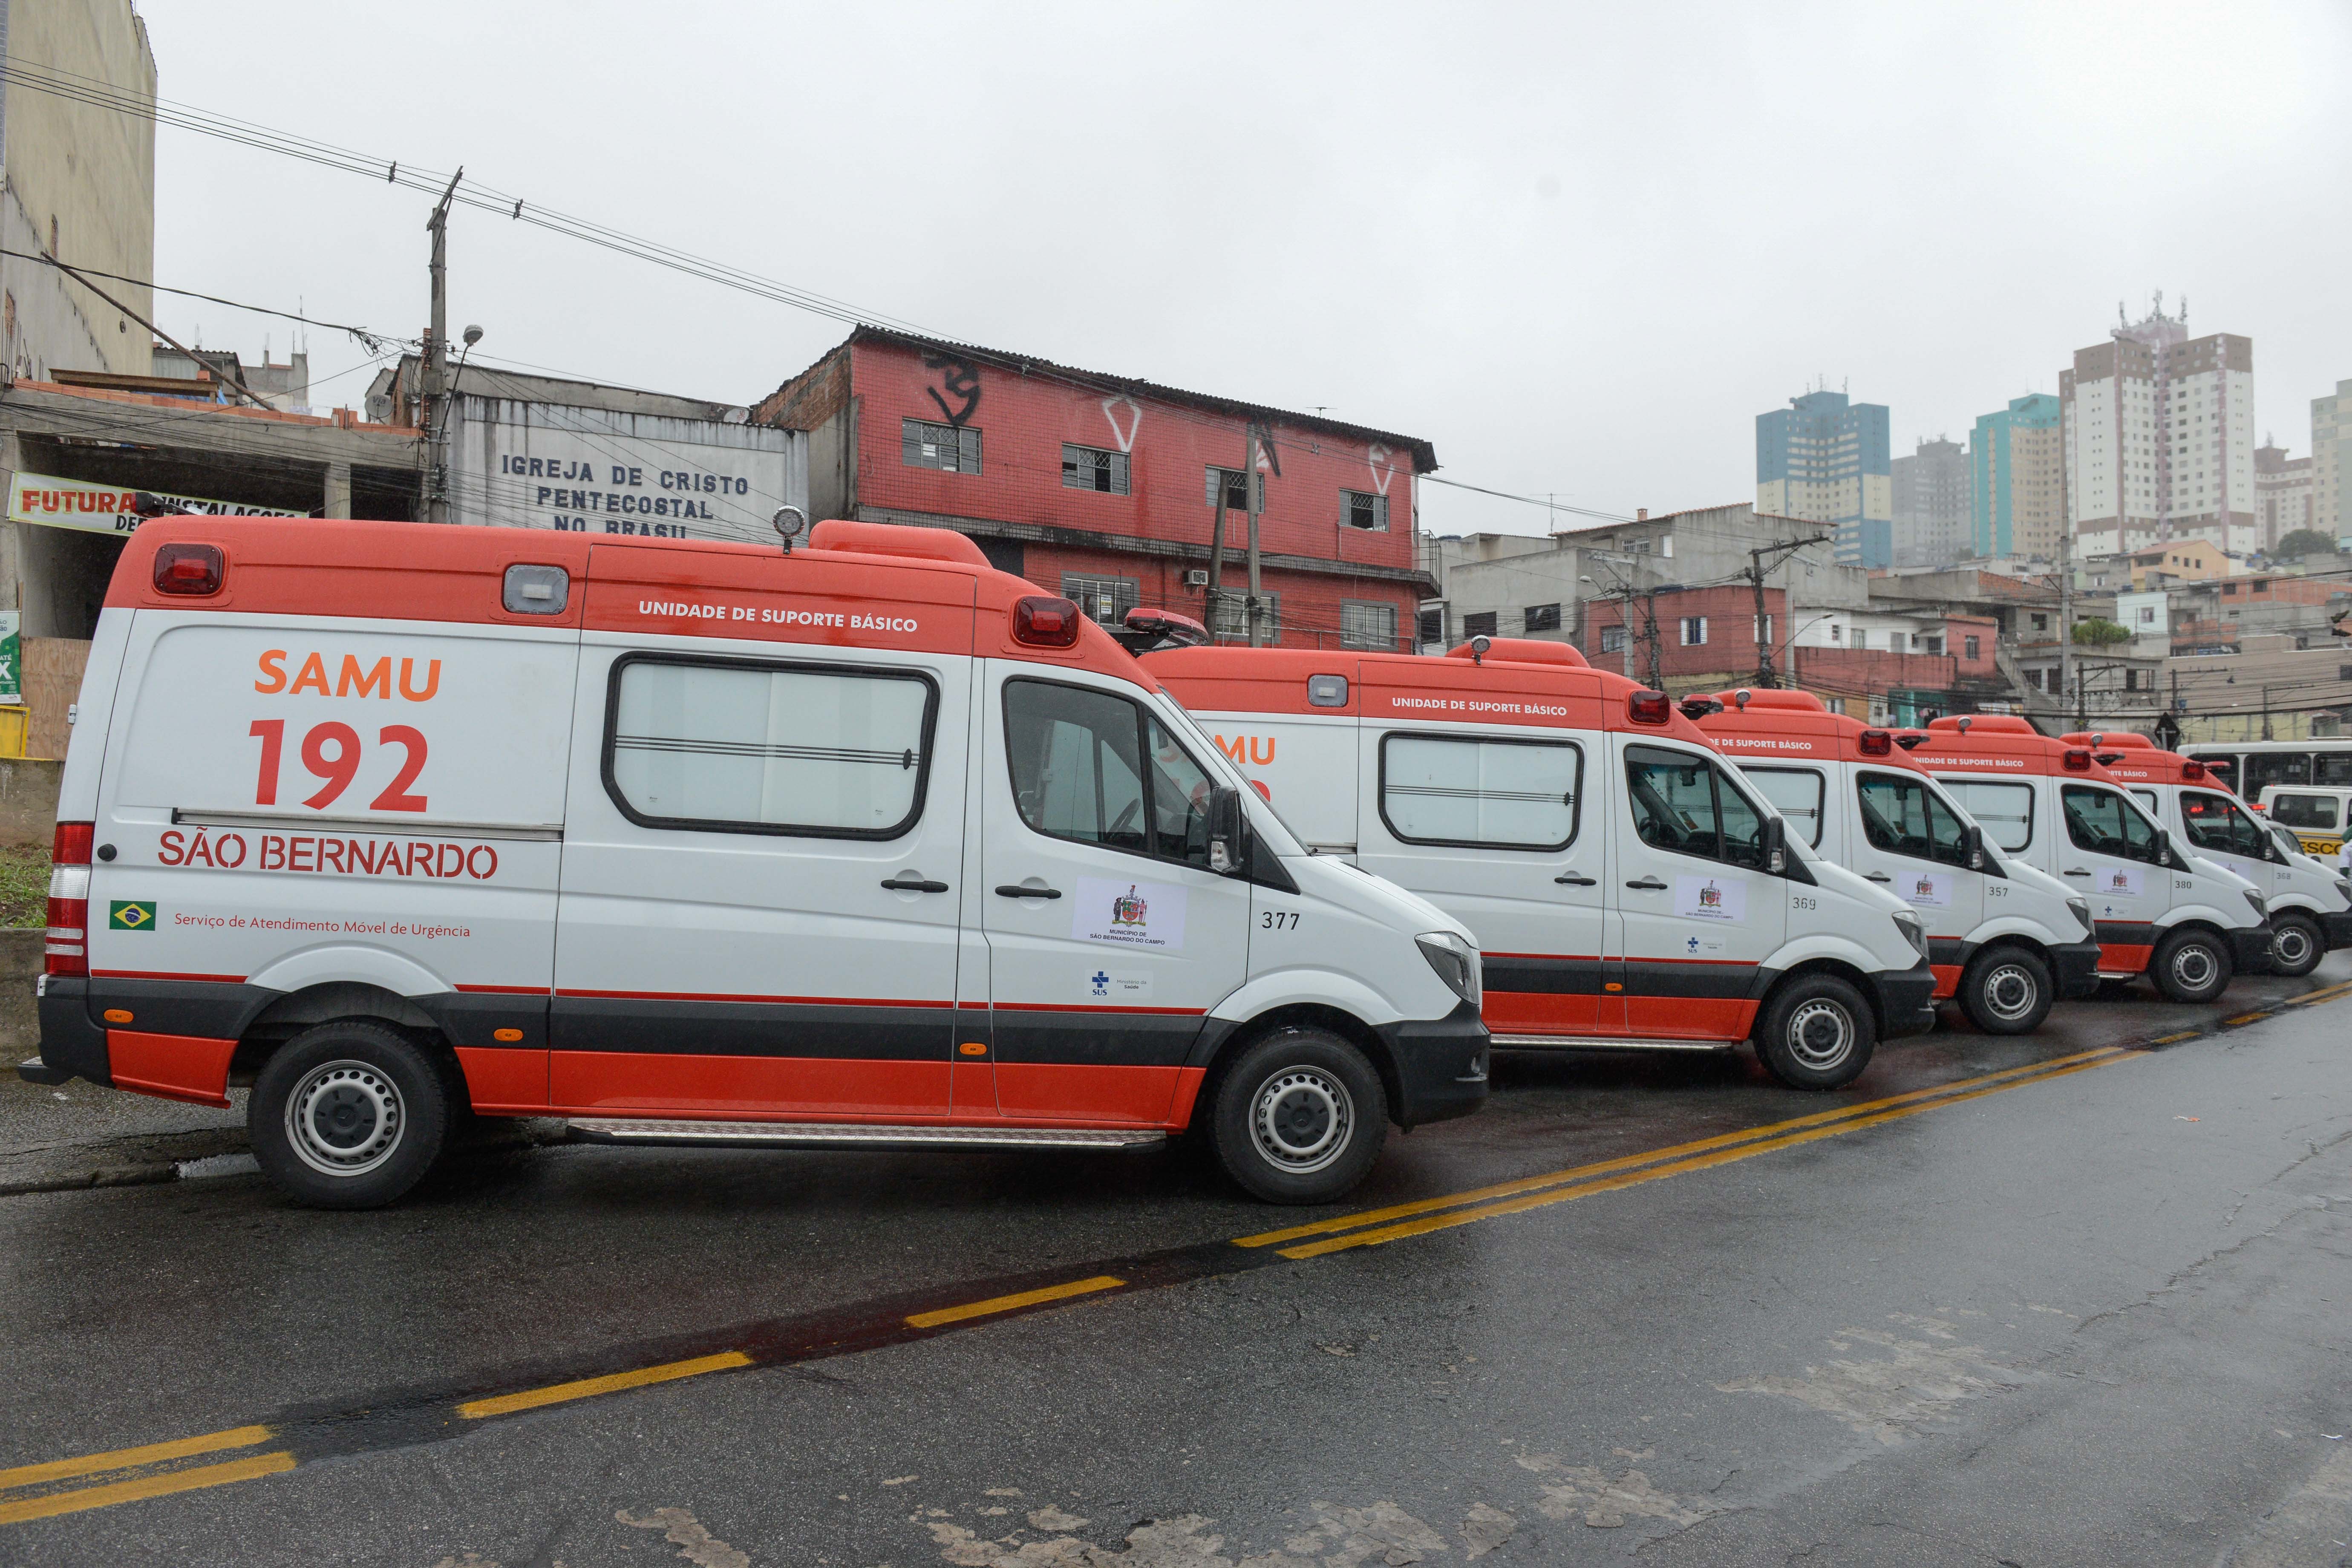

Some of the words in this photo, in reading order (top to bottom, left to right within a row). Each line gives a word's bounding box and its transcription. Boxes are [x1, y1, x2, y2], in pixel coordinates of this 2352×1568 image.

[503, 455, 593, 481] IGREJA
[612, 466, 642, 485] DE
[661, 470, 748, 495] CRISTO
[538, 486, 713, 519] PENTECOSTAL
[554, 516, 585, 531] NO
[639, 601, 726, 619] UNIDADE
[732, 607, 755, 621] DE
[762, 609, 844, 627] SUPORTE
[851, 613, 917, 632] BÁSICO
[255, 649, 441, 702] SAMU
[1392, 698, 1447, 709] UNIDADE
[1450, 700, 1465, 710] DE
[1469, 702, 1521, 713] SUPORTE
[1525, 703, 1567, 716] BÁSICO
[1215, 735, 1275, 765] MU
[1736, 739, 1776, 748] SUPORTE
[1779, 740, 1812, 750] BÁSICO
[249, 719, 427, 812] 192
[1995, 759, 2024, 767] BÁSICO
[159, 826, 246, 869] SÃO
[260, 835, 498, 880] BERNARDO
[1989, 887, 2008, 896] 357
[2175, 881, 2191, 889] 380
[1793, 897, 1816, 910] 369
[175, 914, 224, 928] Serviço
[229, 915, 245, 927] de
[250, 917, 339, 932] Atendimento
[344, 921, 385, 933] Móvel
[390, 922, 406, 934] de
[412, 924, 470, 939] Urgência
[1262, 912, 1300, 930] 377
